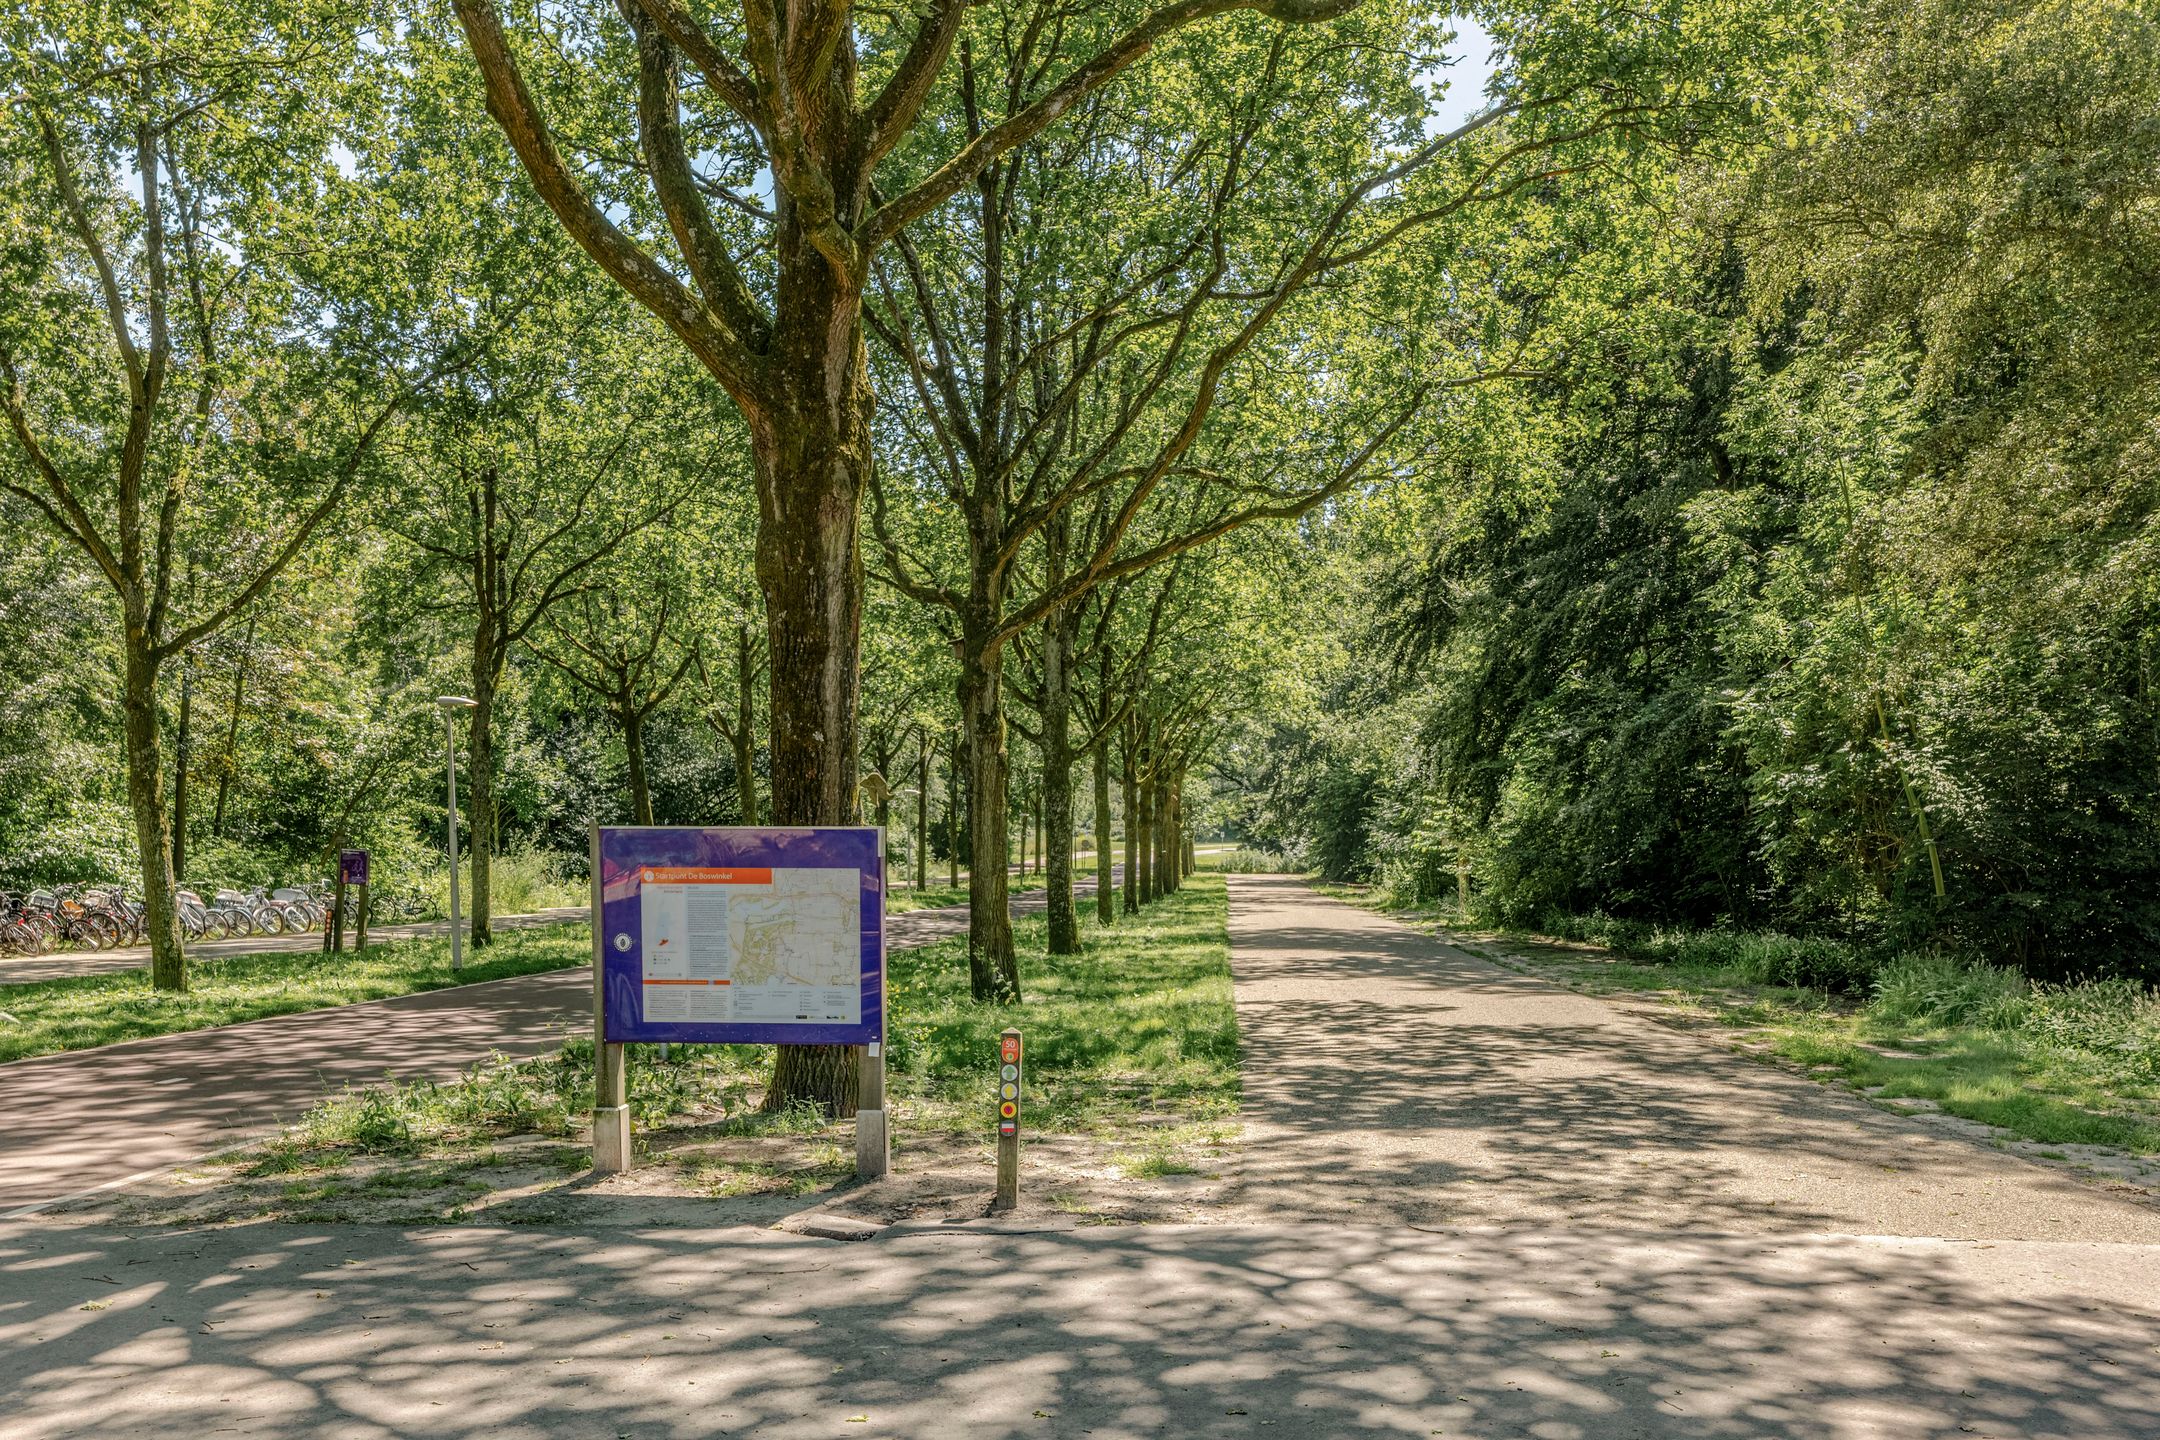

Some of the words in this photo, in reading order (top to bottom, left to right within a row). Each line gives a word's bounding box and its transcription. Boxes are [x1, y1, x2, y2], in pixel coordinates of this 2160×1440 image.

[655, 872, 687, 881] Startpunt
[688, 872, 698, 880] De
[699, 871, 733, 880] Boswinkel
[1005, 1040, 1016, 1048] 50
